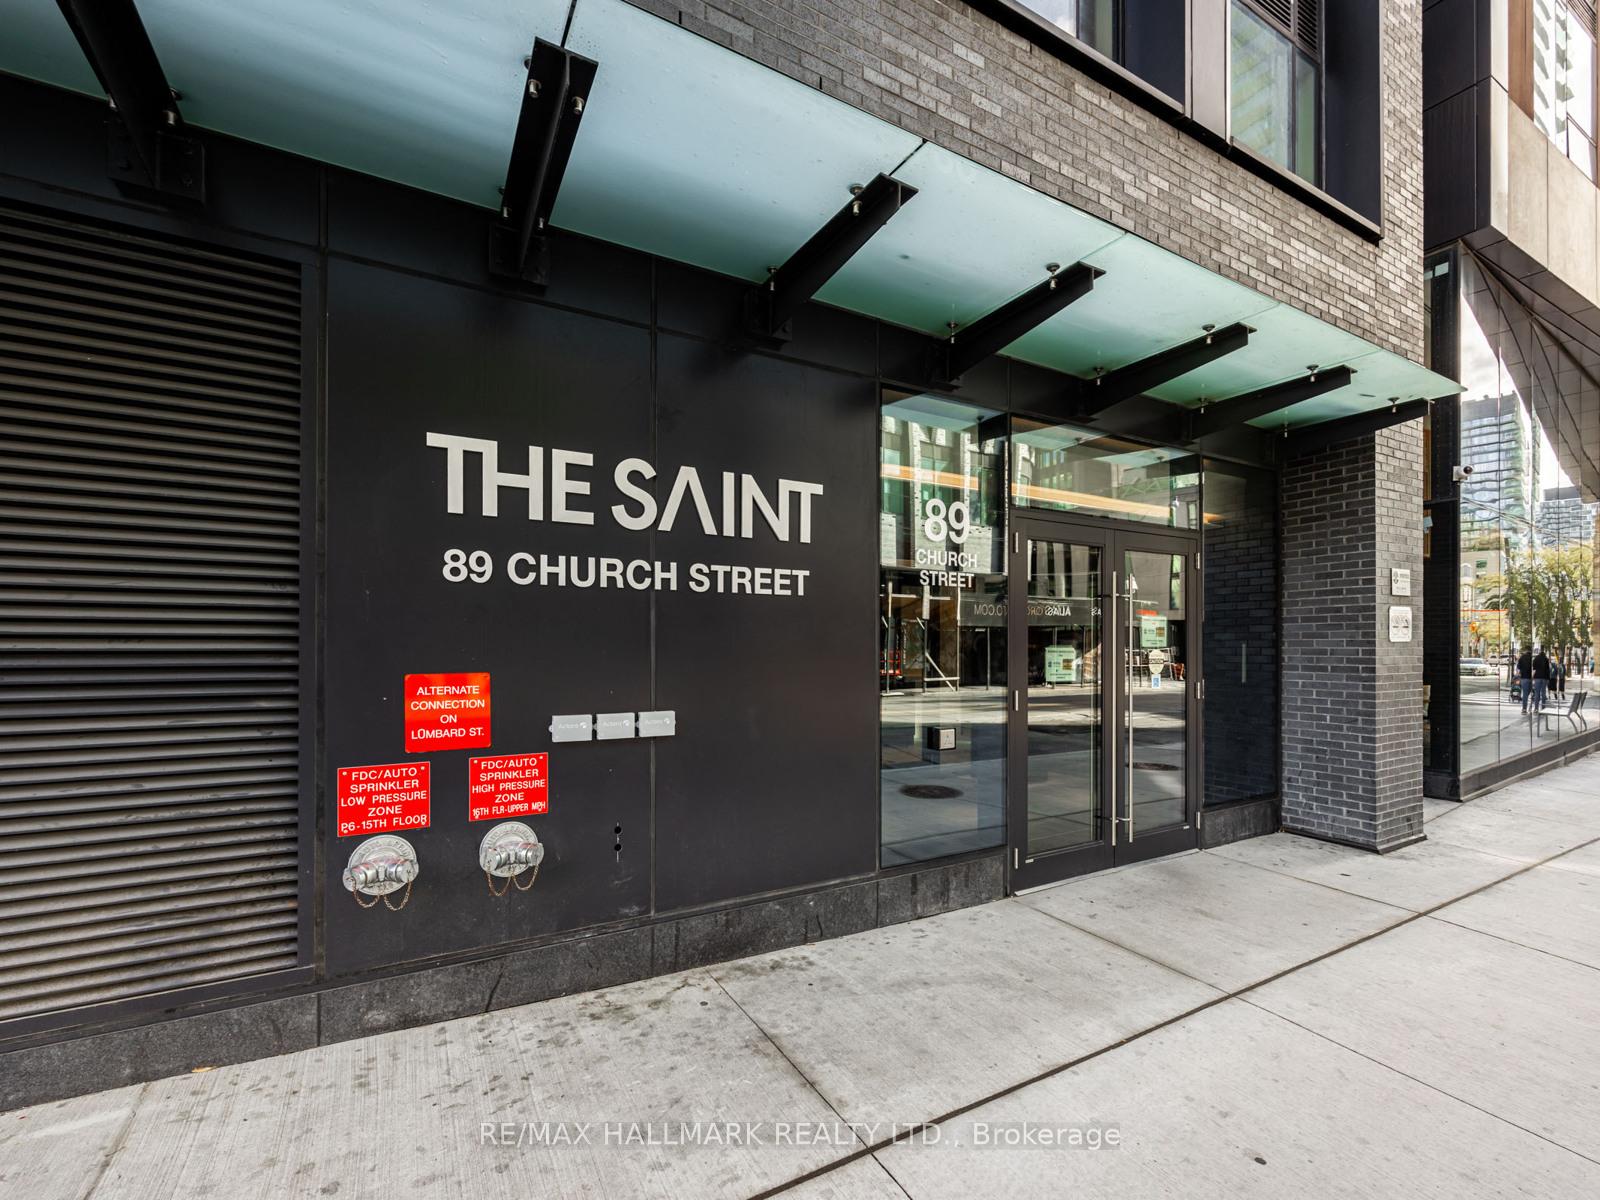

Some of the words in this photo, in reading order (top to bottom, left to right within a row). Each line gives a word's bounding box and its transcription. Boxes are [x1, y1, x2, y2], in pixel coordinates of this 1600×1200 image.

[426, 431, 594, 525] THE
[611, 457, 824, 544] SAINT
[924, 498, 970, 545] 89
[916, 548, 978, 569] CHURCH
[442, 548, 493, 583] 89
[507, 552, 677, 591] CHURCH
[688, 563, 810, 596] STREET
[920, 569, 975, 588] STREET
[416, 685, 480, 696] ALTERNATE
[410, 699, 485, 711] CONNECTION
[440, 714, 457, 724] ON
[411, 728, 466, 740] LOMBARD
[469, 727, 484, 737] ST.
[481, 758, 538, 770] FDC/AUTO
[351, 767, 417, 781] FDC/AUTO
[479, 768, 539, 782] SPRINKLER
[350, 779, 419, 794] SPRINKLER
[472, 783, 495, 794] HIGH
[500, 779, 546, 791] PRESSURE
[341, 796, 366, 807] LOW
[372, 790, 427, 804] PRESSURE
[495, 792, 525, 803] ZONE
[368, 805, 402, 817] ZONE
[492, 802, 528, 815] FLR-UPPER
[393, 814, 427, 827] FLOOR
